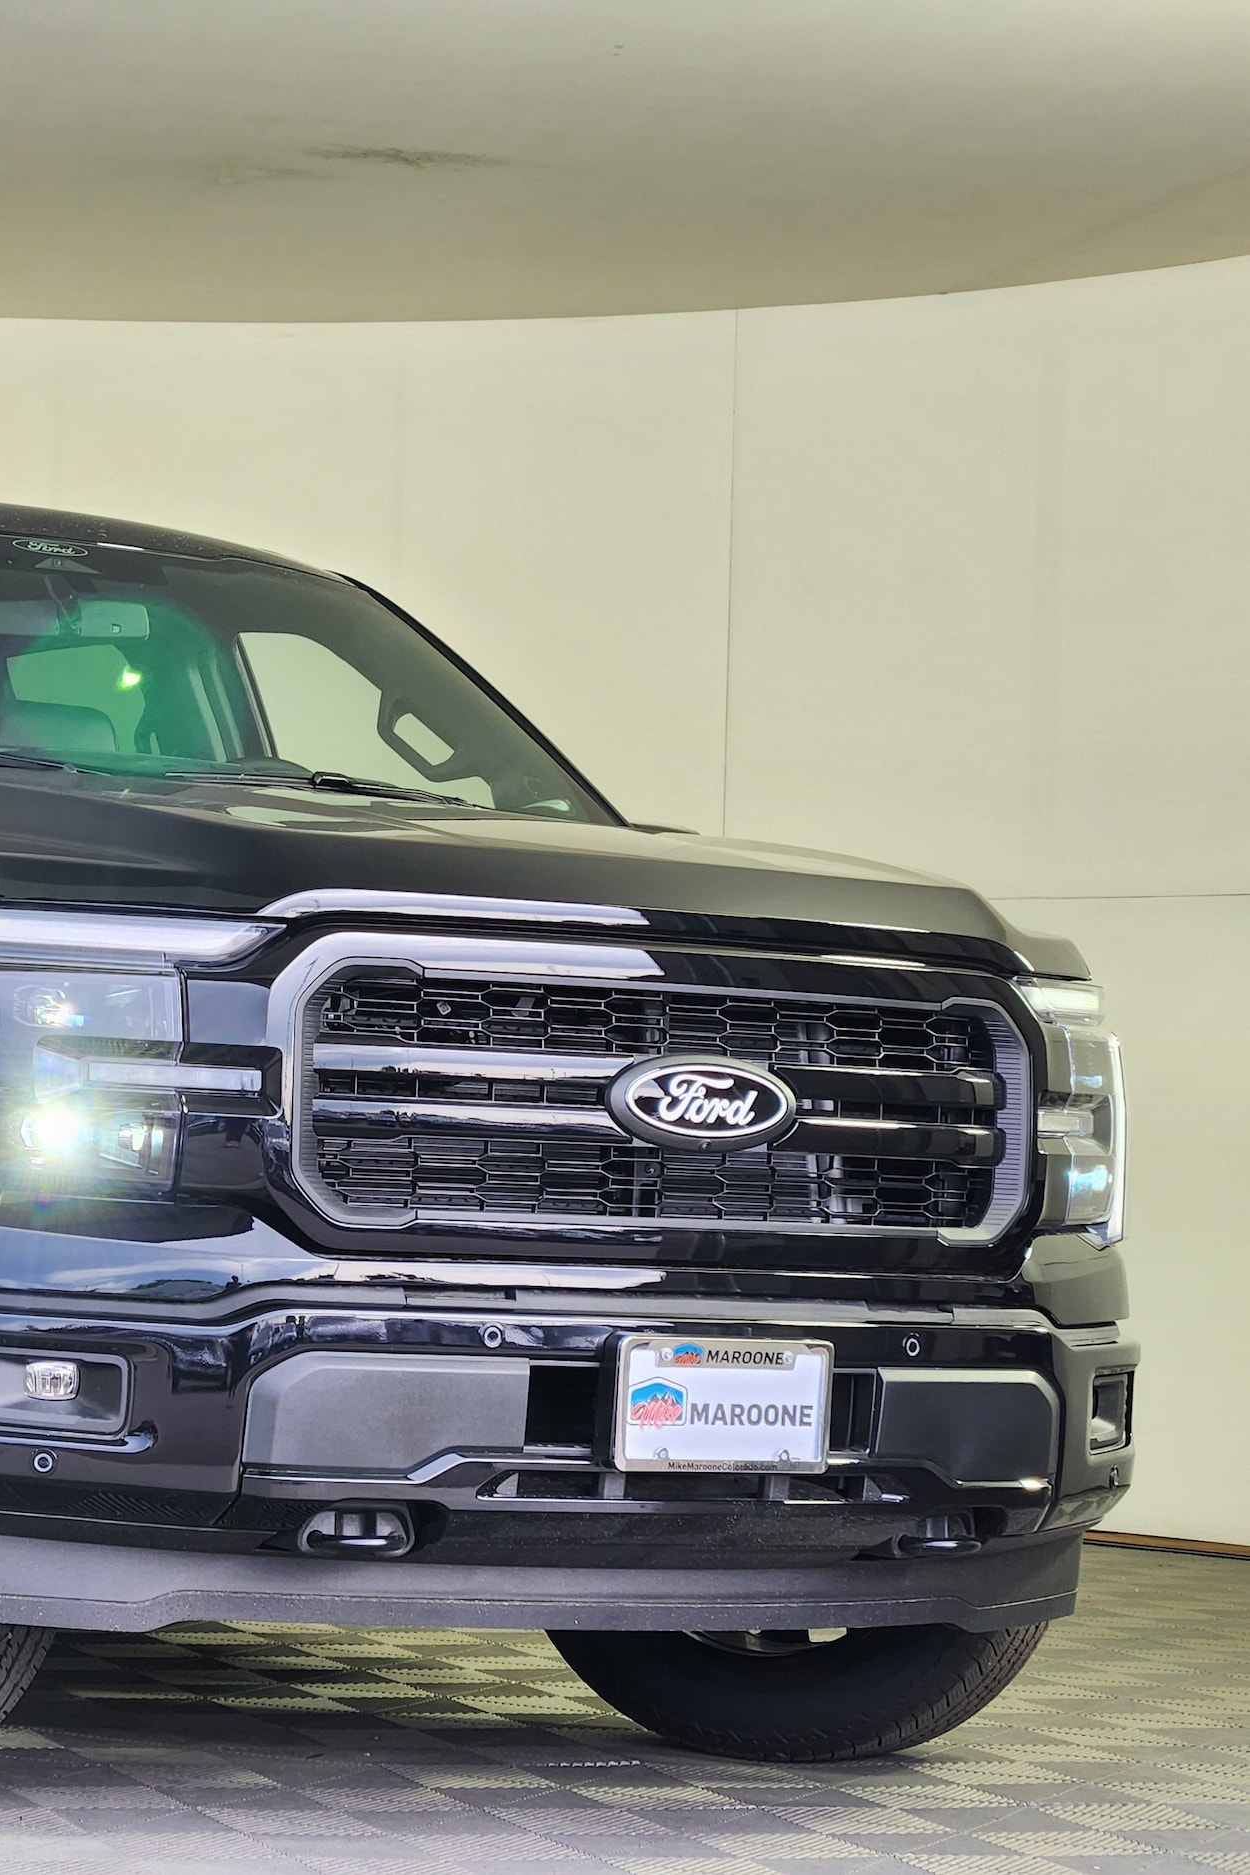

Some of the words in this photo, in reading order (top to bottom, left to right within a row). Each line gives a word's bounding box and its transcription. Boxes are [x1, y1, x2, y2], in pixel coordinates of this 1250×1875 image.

[27, 541, 75, 554] Ford
[659, 1074, 759, 1126] Ford
[706, 1350, 783, 1366] MAROONE
[690, 1403, 814, 1427] MAROONE
